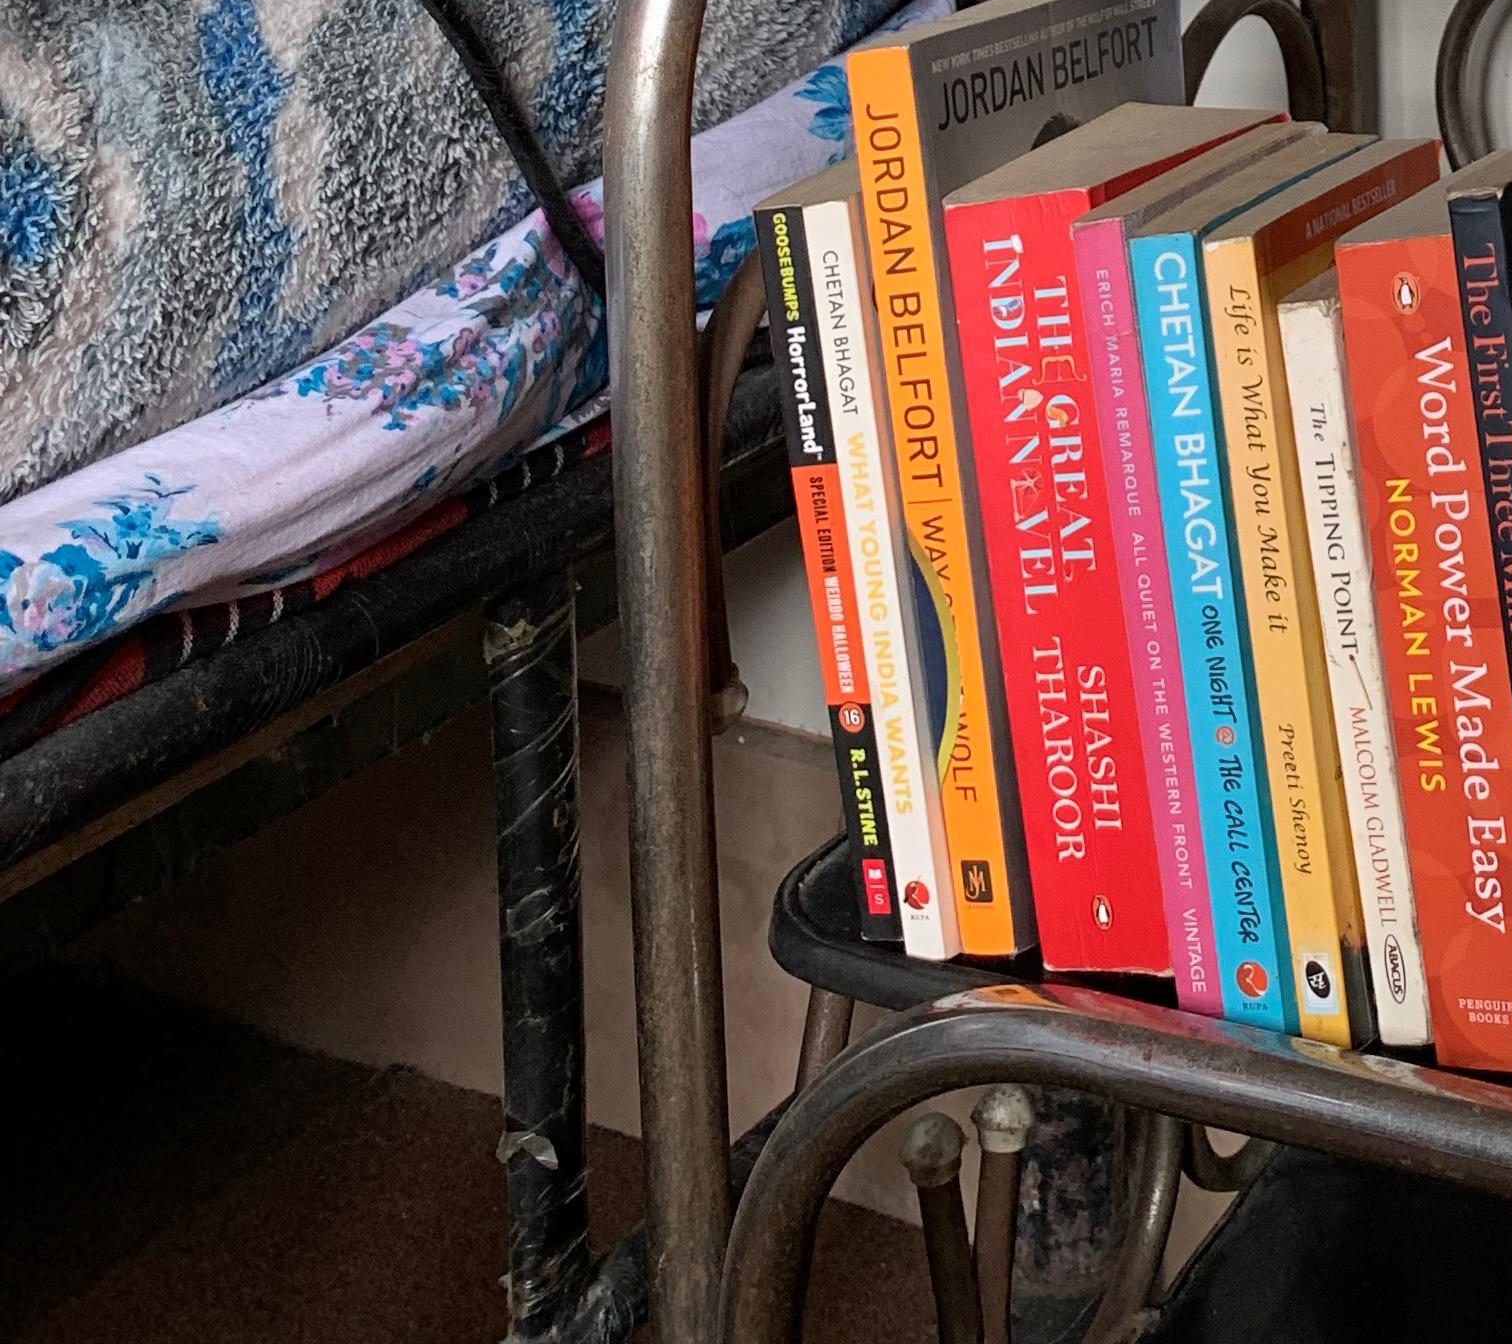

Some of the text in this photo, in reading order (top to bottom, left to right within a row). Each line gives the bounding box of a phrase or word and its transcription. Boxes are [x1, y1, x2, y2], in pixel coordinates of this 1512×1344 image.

[938, 56, 1046, 131] JORDAN
[1054, 16, 1158, 92] BELFORT
[772, 212, 800, 323] GOOSEBUMPS
[866, 104, 917, 276] JORDAN
[982, 233, 1044, 426] INDIAN
[1462, 242, 1500, 326] The
[1473, 332, 1510, 416] First
[889, 291, 945, 488] BELFORT
[1034, 275, 1097, 582] THE GREAT
[1153, 251, 1224, 601] CHETAN BHAGAT
[1224, 284, 1288, 634] Life is What You Make it
[809, 476, 837, 573] SPECIAL EDITION
[822, 250, 913, 816] CHETAN BHAGAT WHAT YOUNG INDIA WANTS
[1309, 403, 1360, 654] The TIPPING POINT
[823, 576, 854, 694] WEIRDO HALLOWEEN
[843, 708, 860, 725] 16
[1095, 270, 1208, 993] ERICH MARIA REMARQUE ALL QUIET ON THE WESTERN FRONT VINTAGE
[1386, 478, 1446, 794] NORMAN LEWIS
[1414, 336, 1508, 935] Word Power Made Easy
[1032, 635, 1087, 863] THAROOR
[1077, 665, 1123, 832] SHASHI
[1202, 604, 1261, 945] ONE NIGHT THE CALL CENTER
[1277, 723, 1313, 875] Preeti Shenoy
[1349, 706, 1399, 929] MALCOLM GLADWELL
[1242, 1001, 1269, 1011] RUPA
[1385, 943, 1404, 996] ABACUS
[1468, 1011, 1510, 1025] BOOKS
